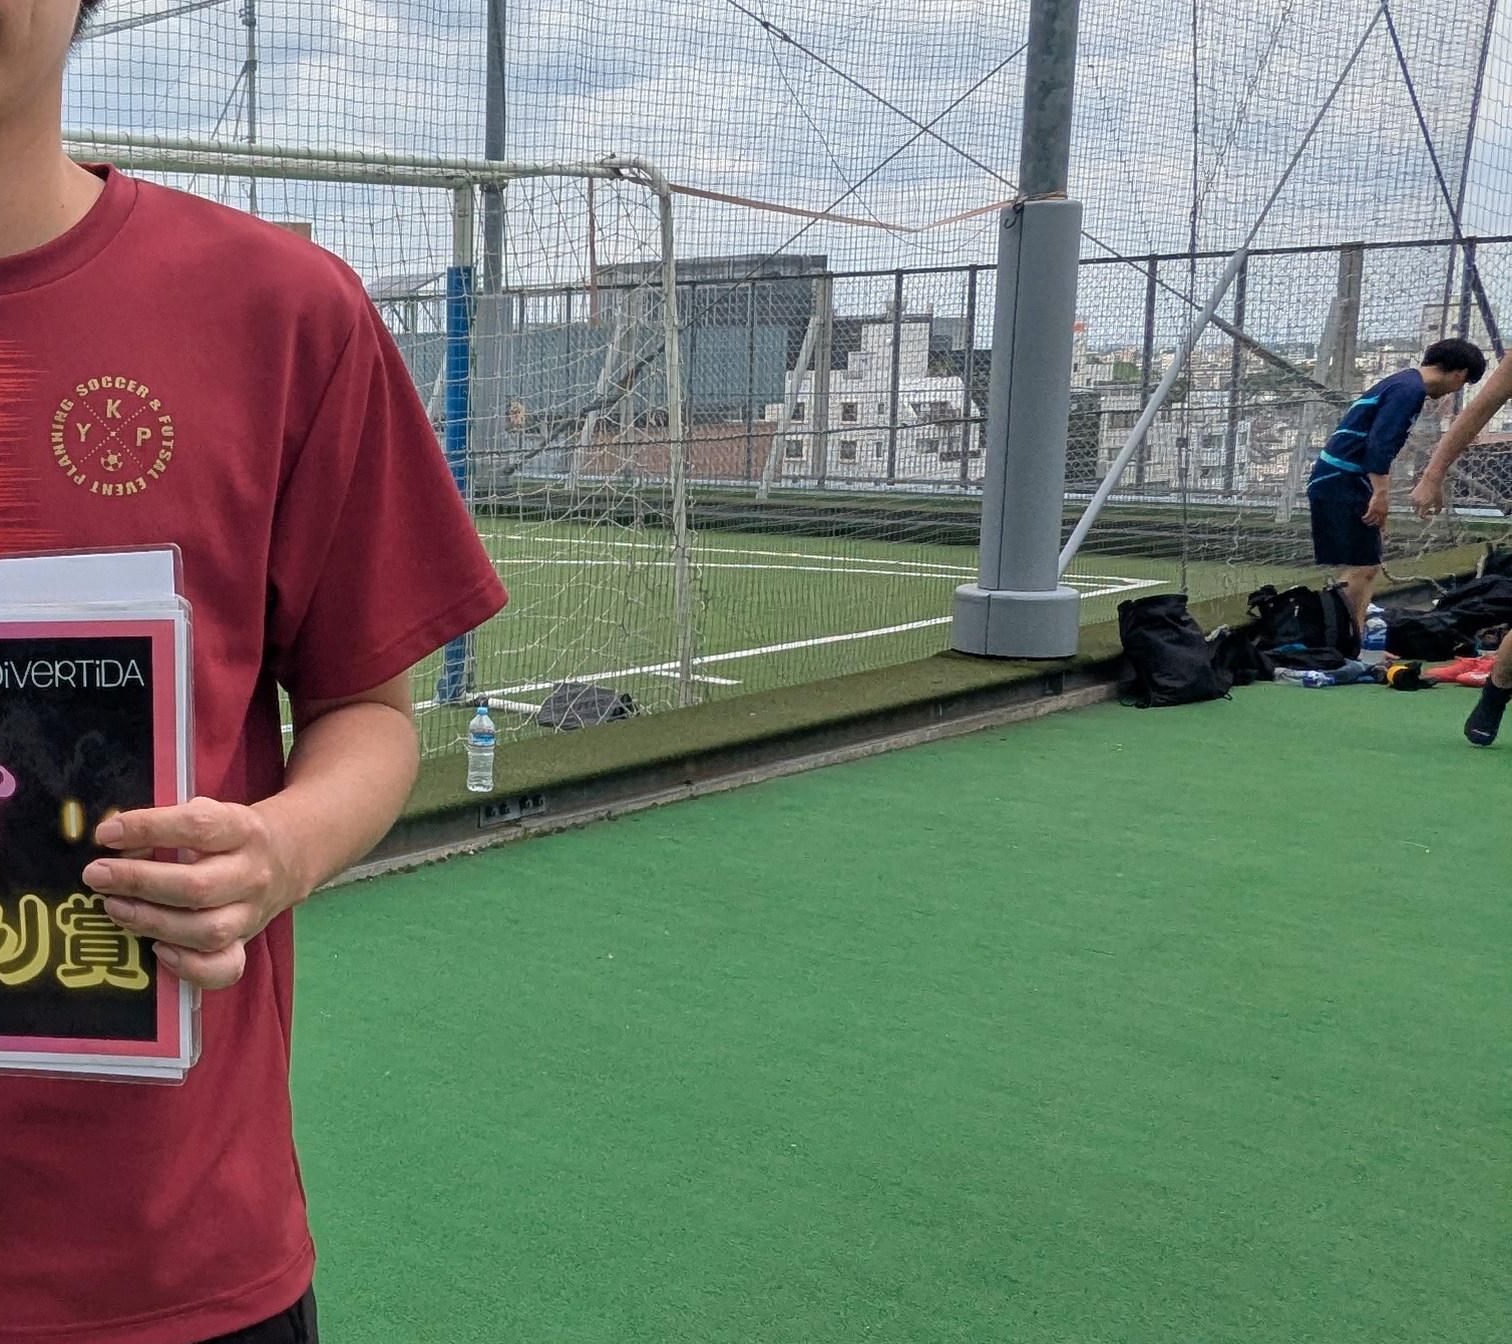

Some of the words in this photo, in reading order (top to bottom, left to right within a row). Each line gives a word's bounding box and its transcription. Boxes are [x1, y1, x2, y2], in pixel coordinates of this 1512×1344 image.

[76, 375, 150, 399] SOCCER
[50, 398, 87, 486] PLANNING
[76, 422, 92, 443] Y
[106, 398, 122, 419] K
[135, 427, 152, 447] P
[146, 414, 175, 480] FUTSAL
[89, 476, 148, 496] EVENT
